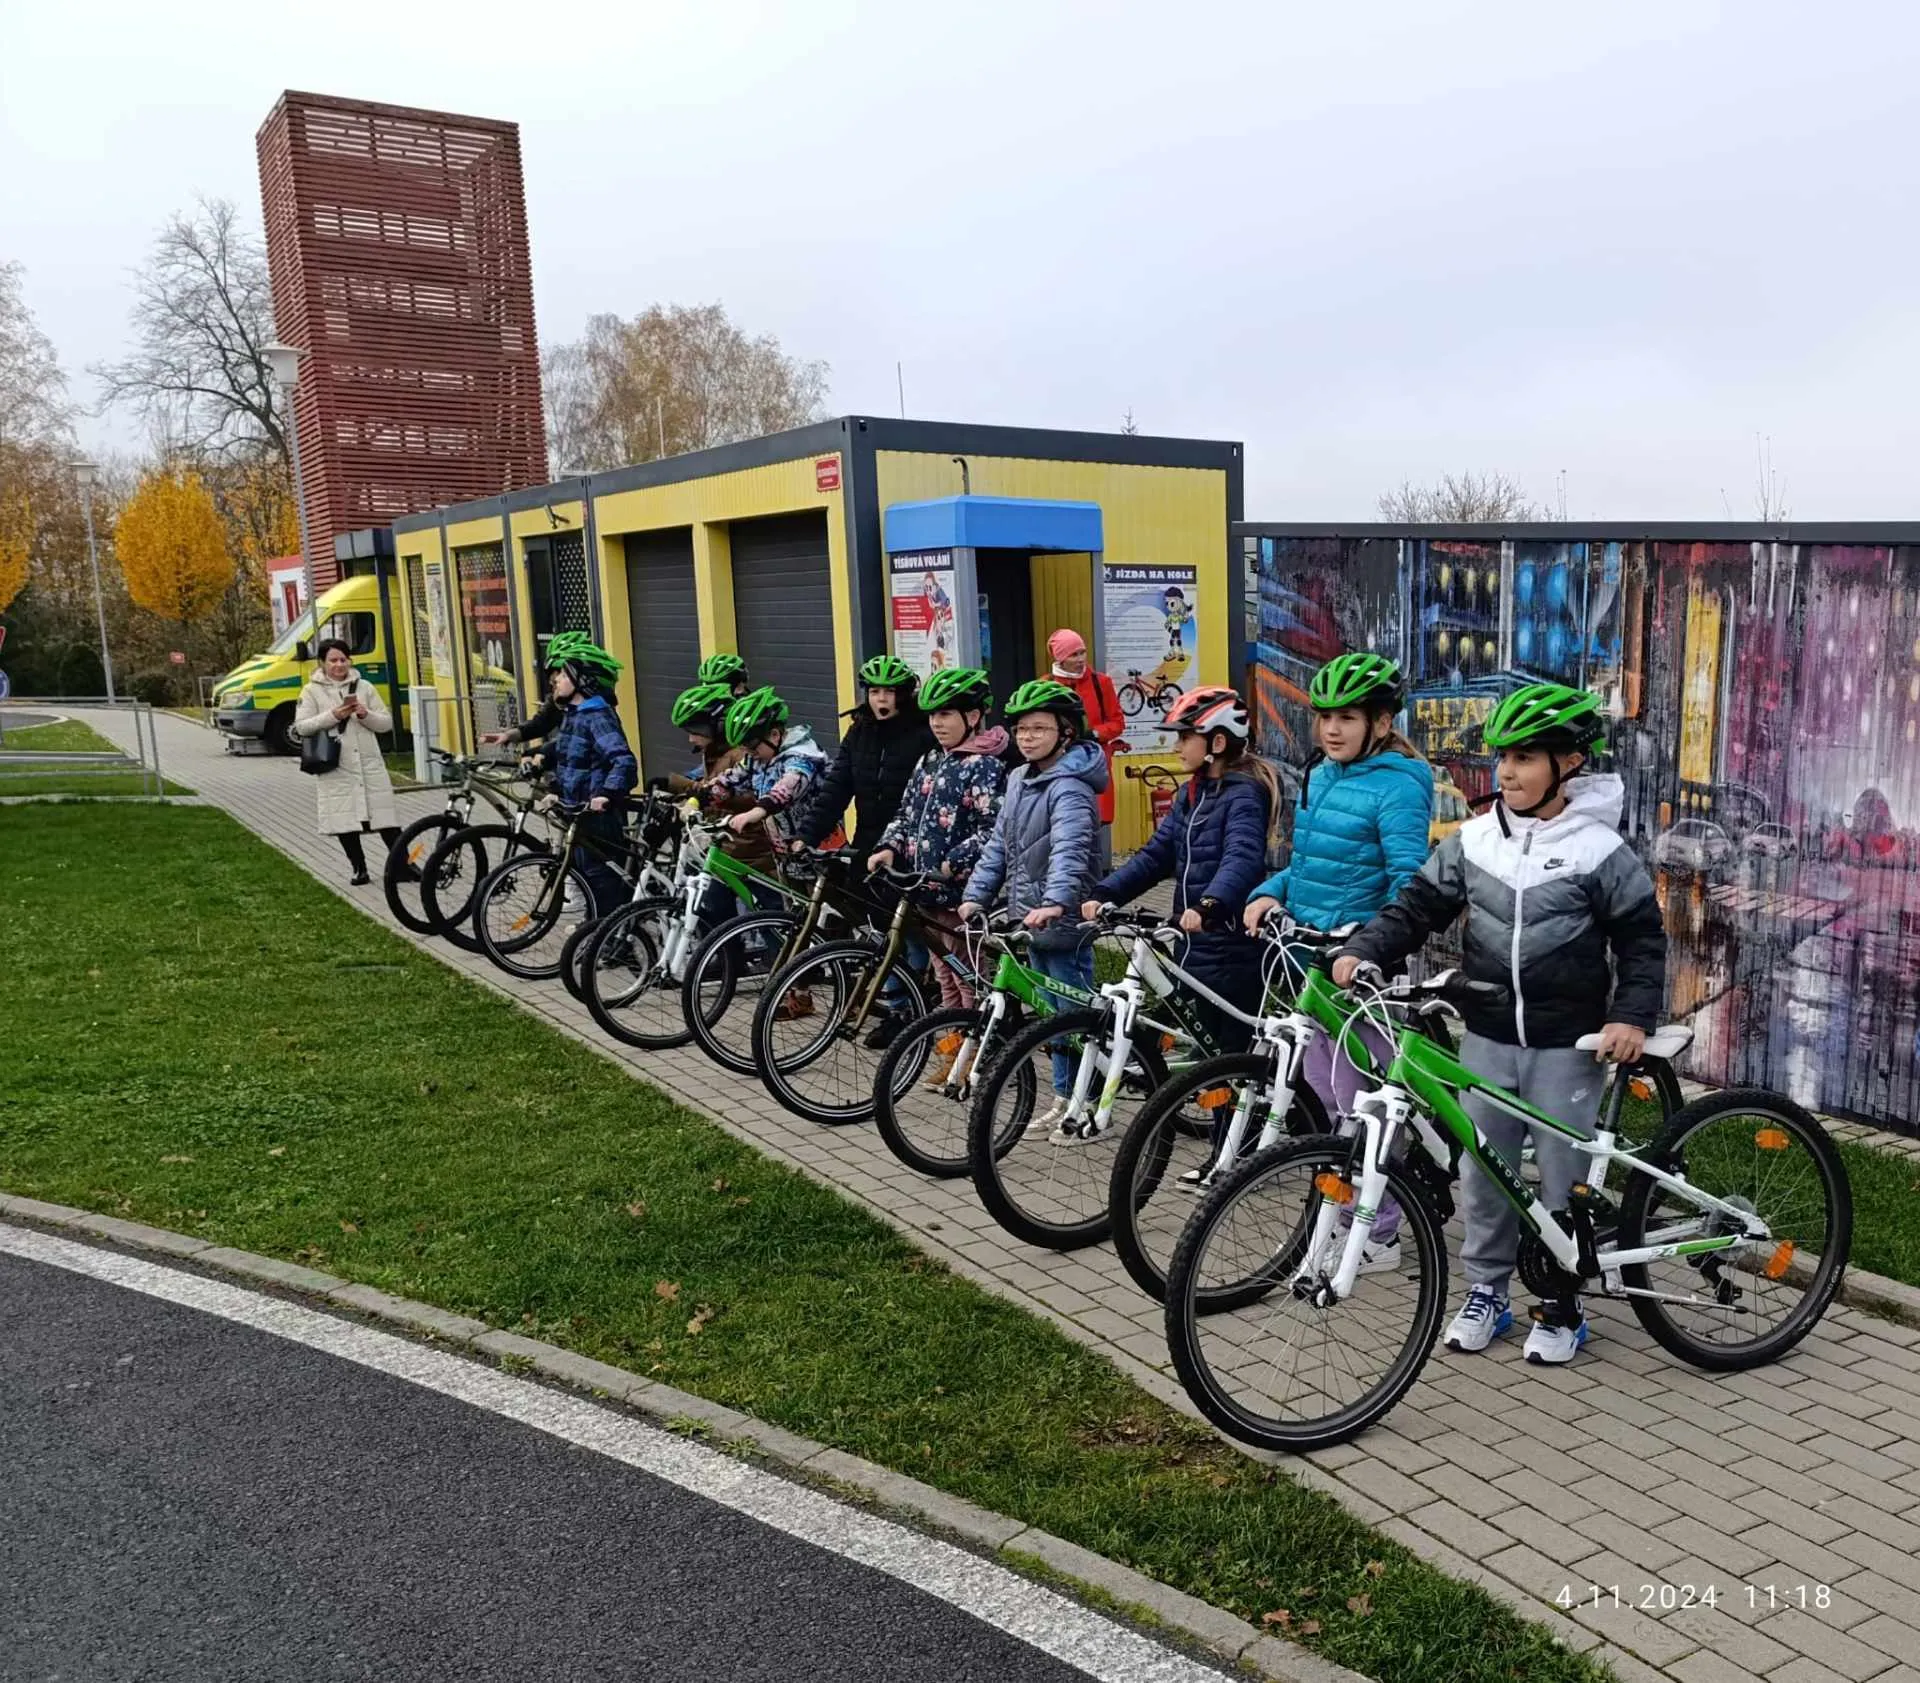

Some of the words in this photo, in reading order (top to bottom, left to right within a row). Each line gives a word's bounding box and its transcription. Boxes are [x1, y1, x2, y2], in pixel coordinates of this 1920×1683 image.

[1116, 568, 1146, 579] JÍZDA
[1149, 570, 1165, 579] NA
[1167, 570, 1193, 579] KOLE
